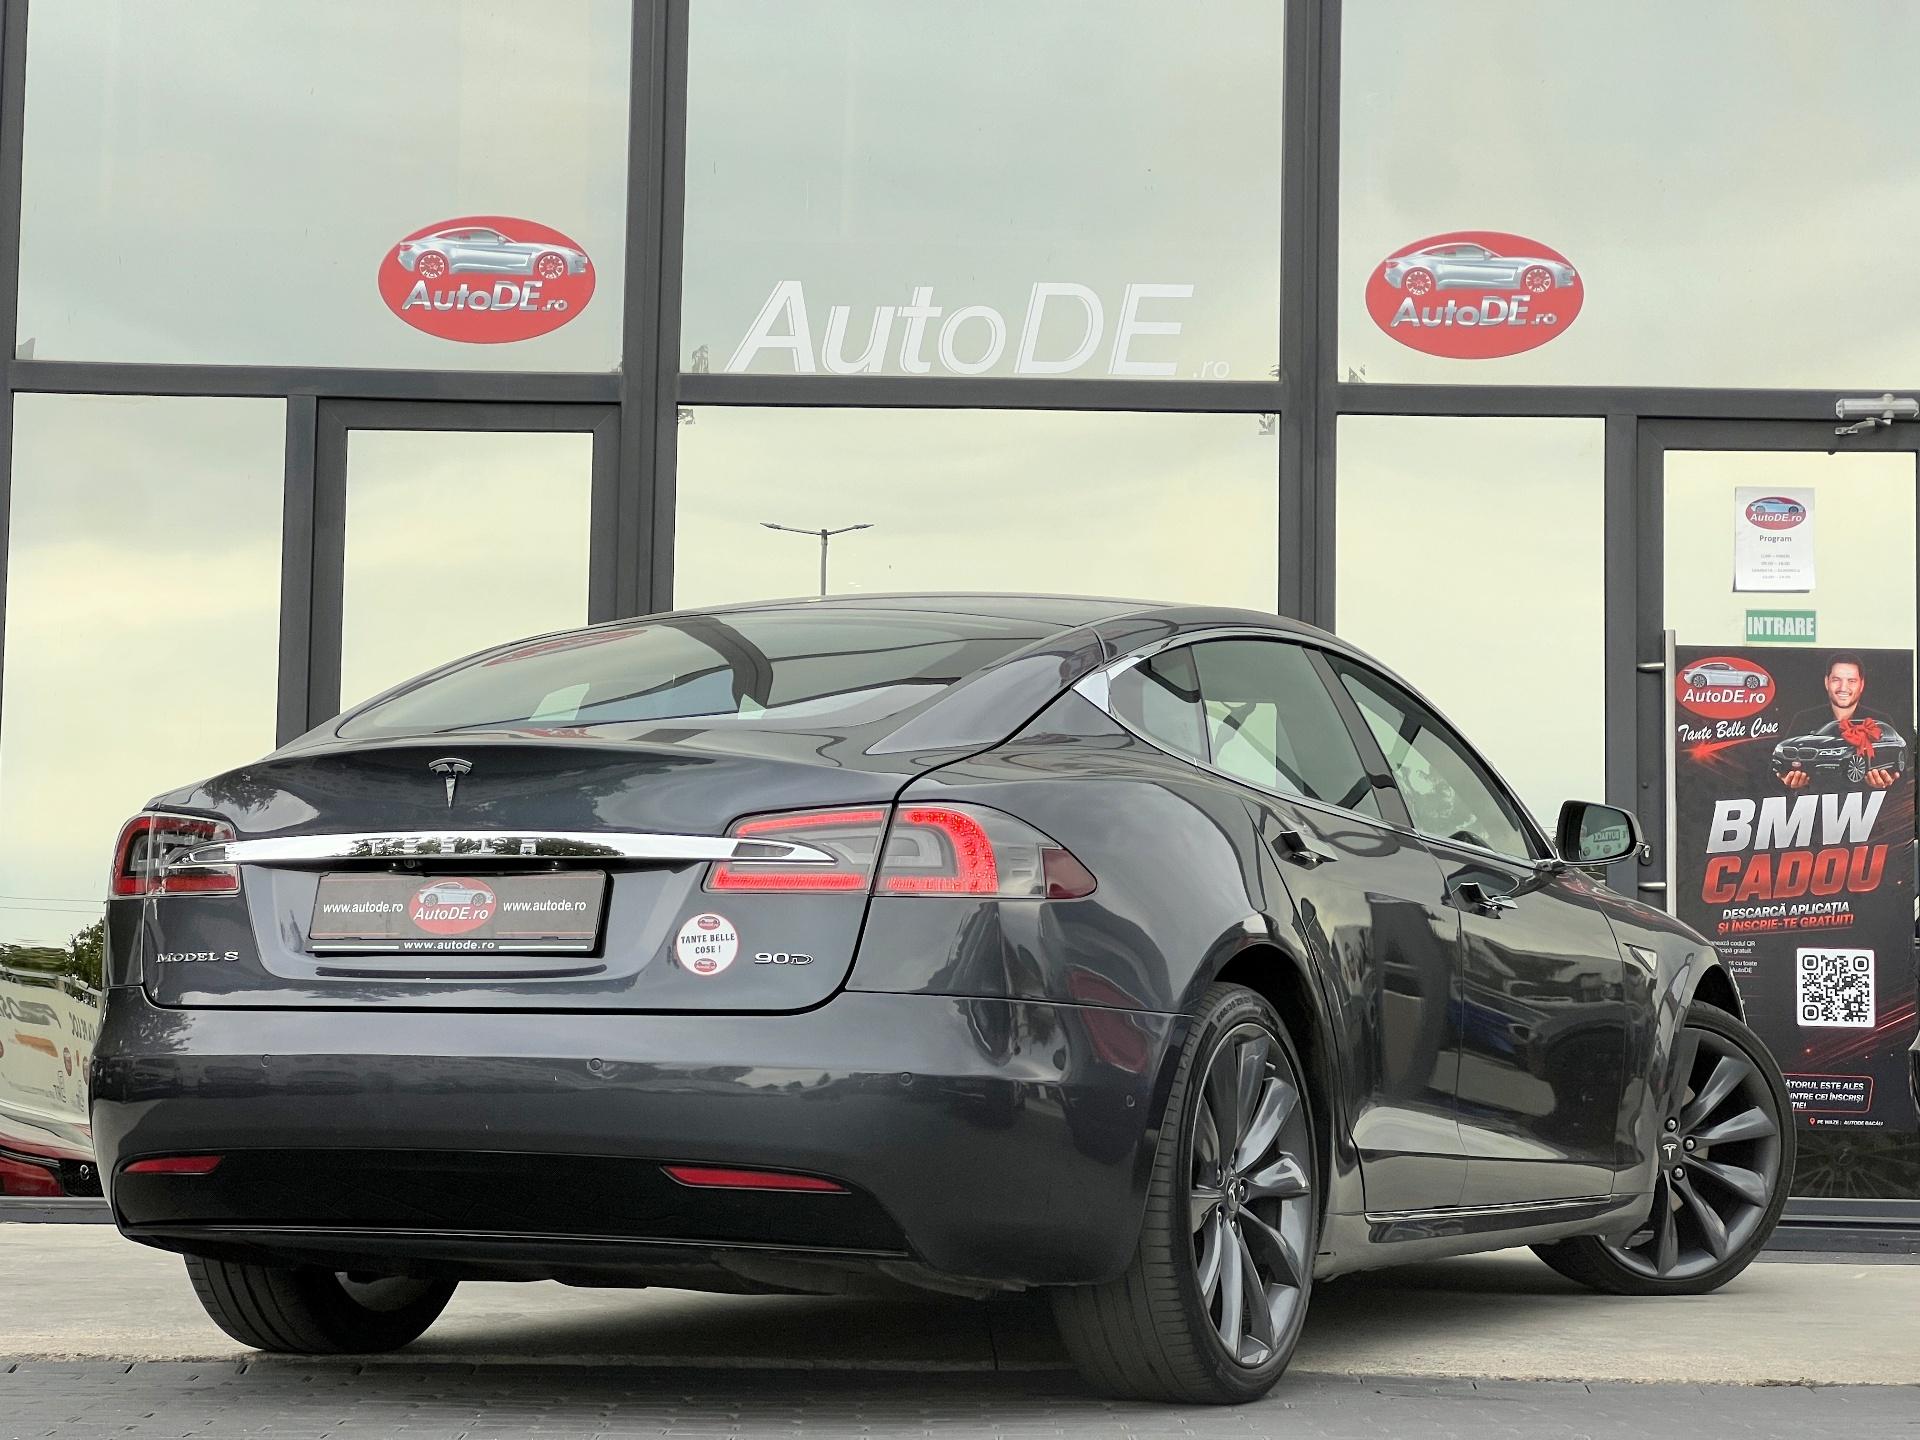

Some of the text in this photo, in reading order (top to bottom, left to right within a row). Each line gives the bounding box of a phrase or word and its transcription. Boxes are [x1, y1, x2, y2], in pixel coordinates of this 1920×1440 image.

[1750, 513, 1802, 522] AutoDE.ro
[1759, 534, 1792, 543] Program
[1747, 616, 1815, 636] INTRARE
[1682, 688, 1766, 704] AutoDE.ro
[1677, 717, 1779, 743] Tante Belle Cose
[1706, 790, 1888, 854] BMW
[368, 838, 538, 856] TESLA
[1701, 843, 1889, 904] CADOU
[323, 901, 404, 914] www.autode.ro
[503, 899, 587, 912] www.autode.ro
[1722, 902, 1787, 920] DESCARCĂ
[413, 906, 489, 921] AutoDE.ro
[681, 932, 736, 944] TANTE BELLE
[403, 940, 495, 950] www.autode.ro
[695, 945, 716, 954] COSE
[155, 951, 239, 963] MODEL S
[754, 952, 814, 965] 90D
[1820, 1081, 1841, 1090] ESTE
[1842, 1082, 1864, 1091] ALES
